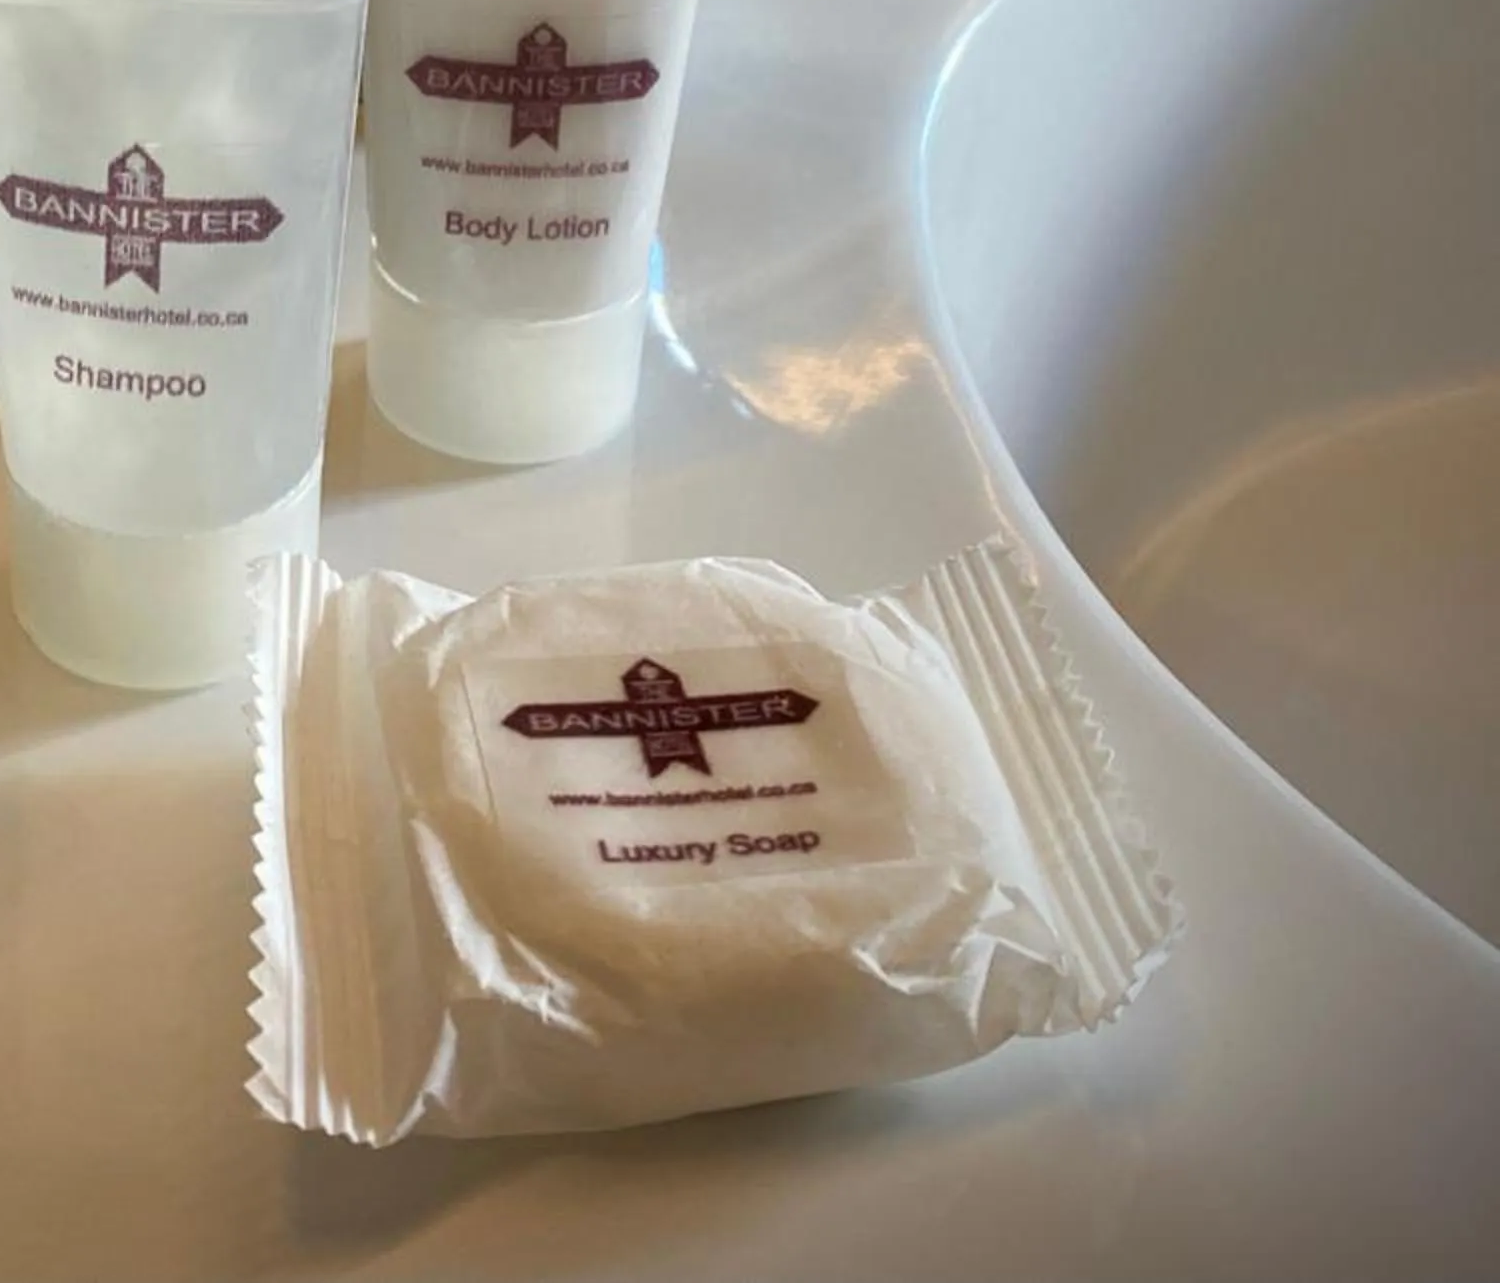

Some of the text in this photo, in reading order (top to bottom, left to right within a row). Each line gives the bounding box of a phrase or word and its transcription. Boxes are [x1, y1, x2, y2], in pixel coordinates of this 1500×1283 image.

[426, 67, 643, 97] BANNISTER
[13, 186, 261, 234] BANNISTER
[445, 211, 610, 245] Body Lotion
[53, 354, 207, 400] Shampoo
[529, 696, 797, 733] BANNISTER
[598, 830, 821, 866] Luxury Soap
